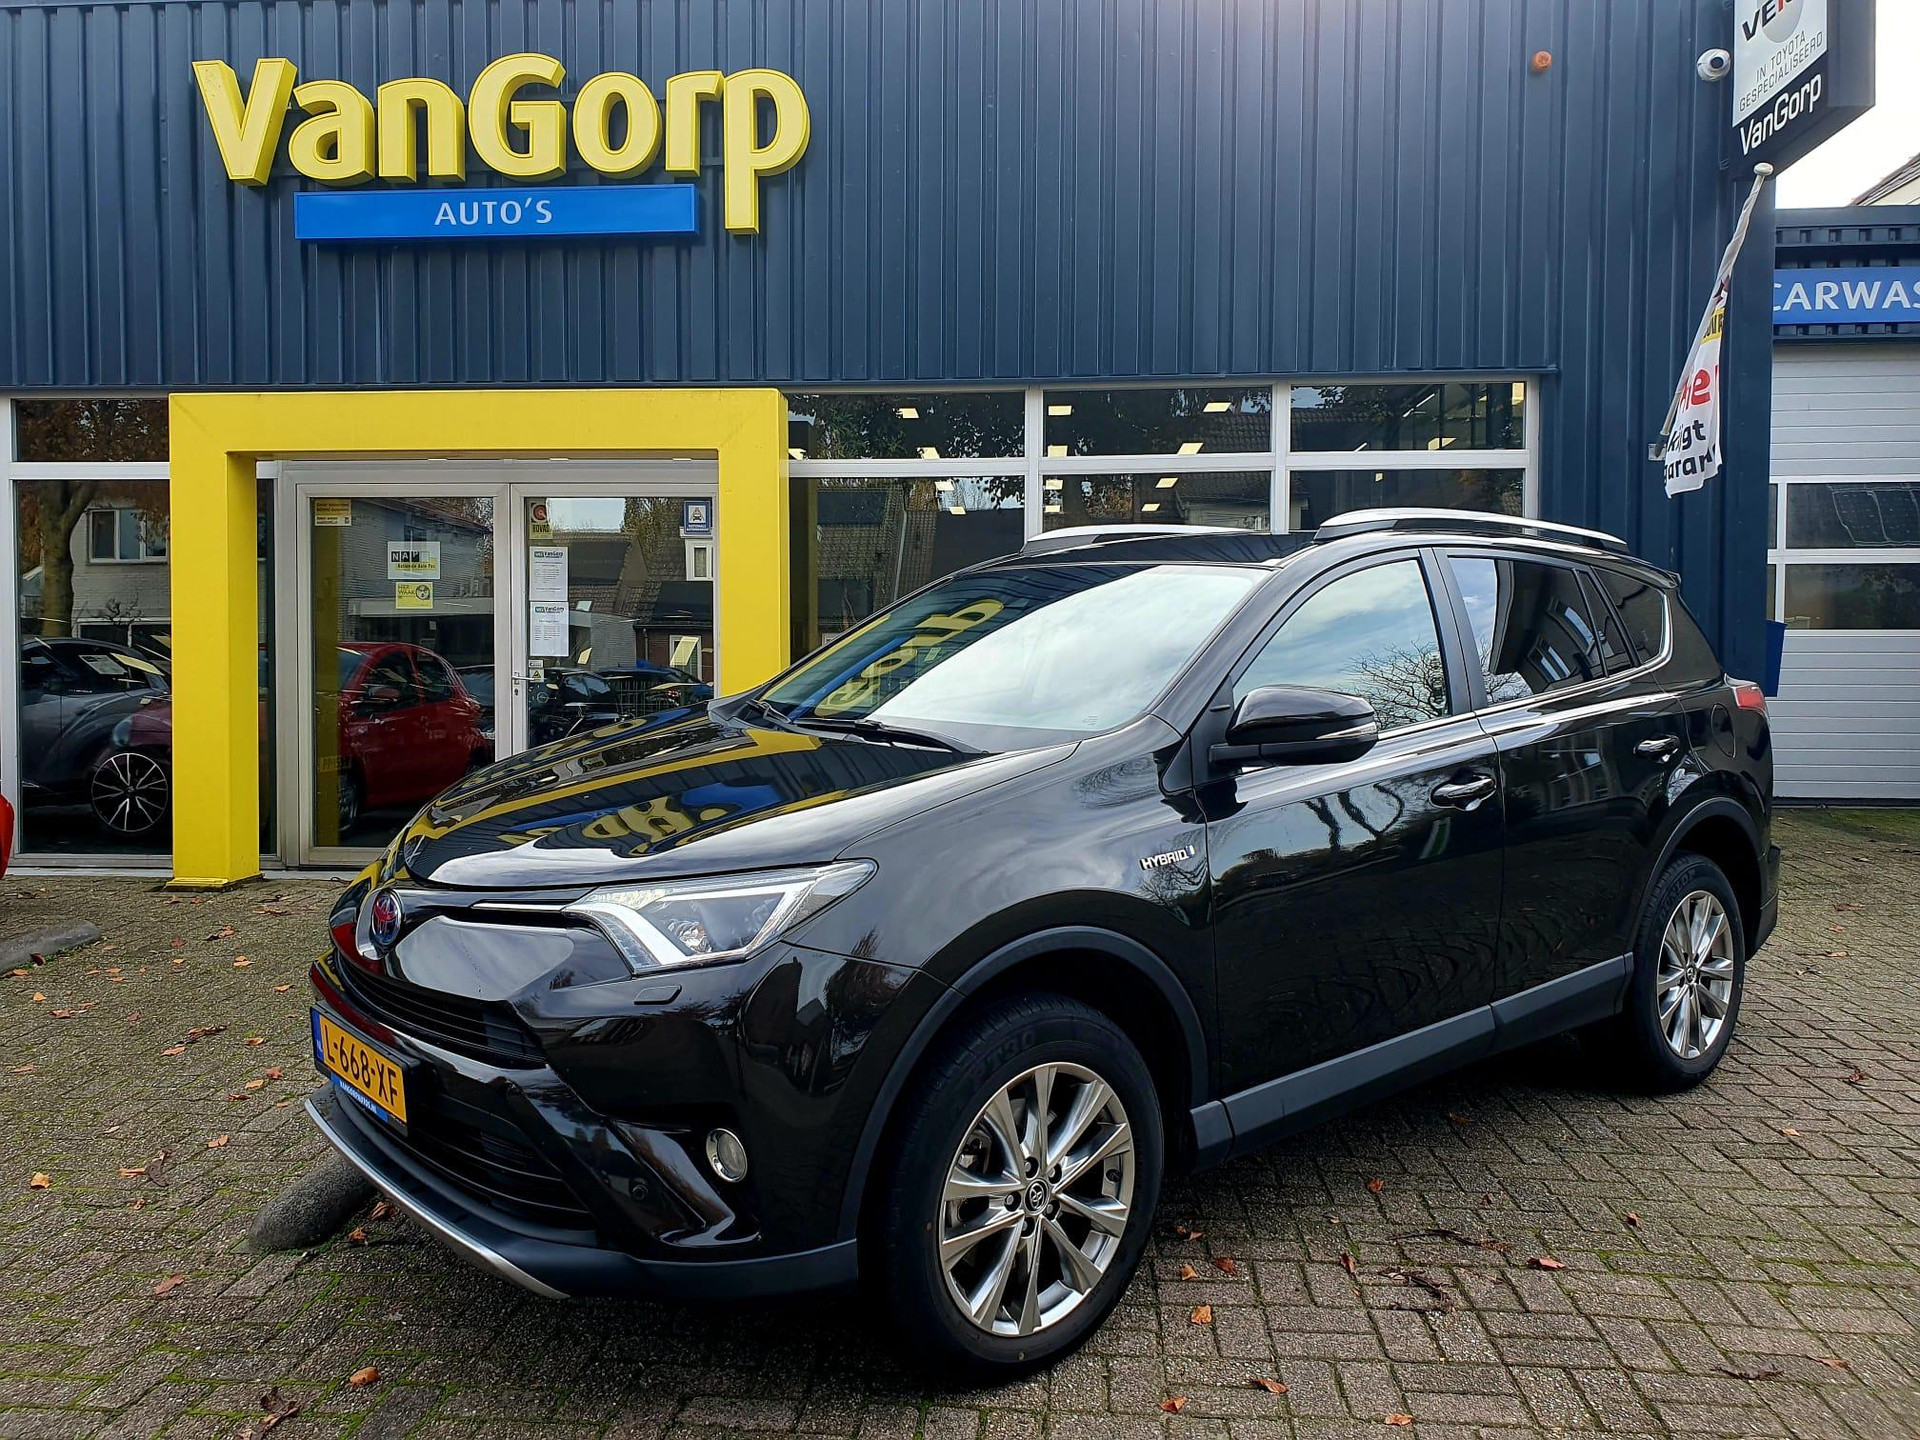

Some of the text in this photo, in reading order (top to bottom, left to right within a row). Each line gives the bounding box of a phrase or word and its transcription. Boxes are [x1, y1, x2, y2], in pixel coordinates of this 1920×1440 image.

[1739, 31, 1823, 112] GESPECIALISEERD
[1756, 30, 1806, 83] IN TOYOTA
[192, 52, 811, 235] VanGorp
[1740, 73, 1822, 156] VanGorp
[434, 198, 553, 226] AUTO'S
[391, 550, 420, 563] NAP
[1140, 848, 1190, 871] HYBRID
[324, 1024, 399, 1107] L-668-XF
